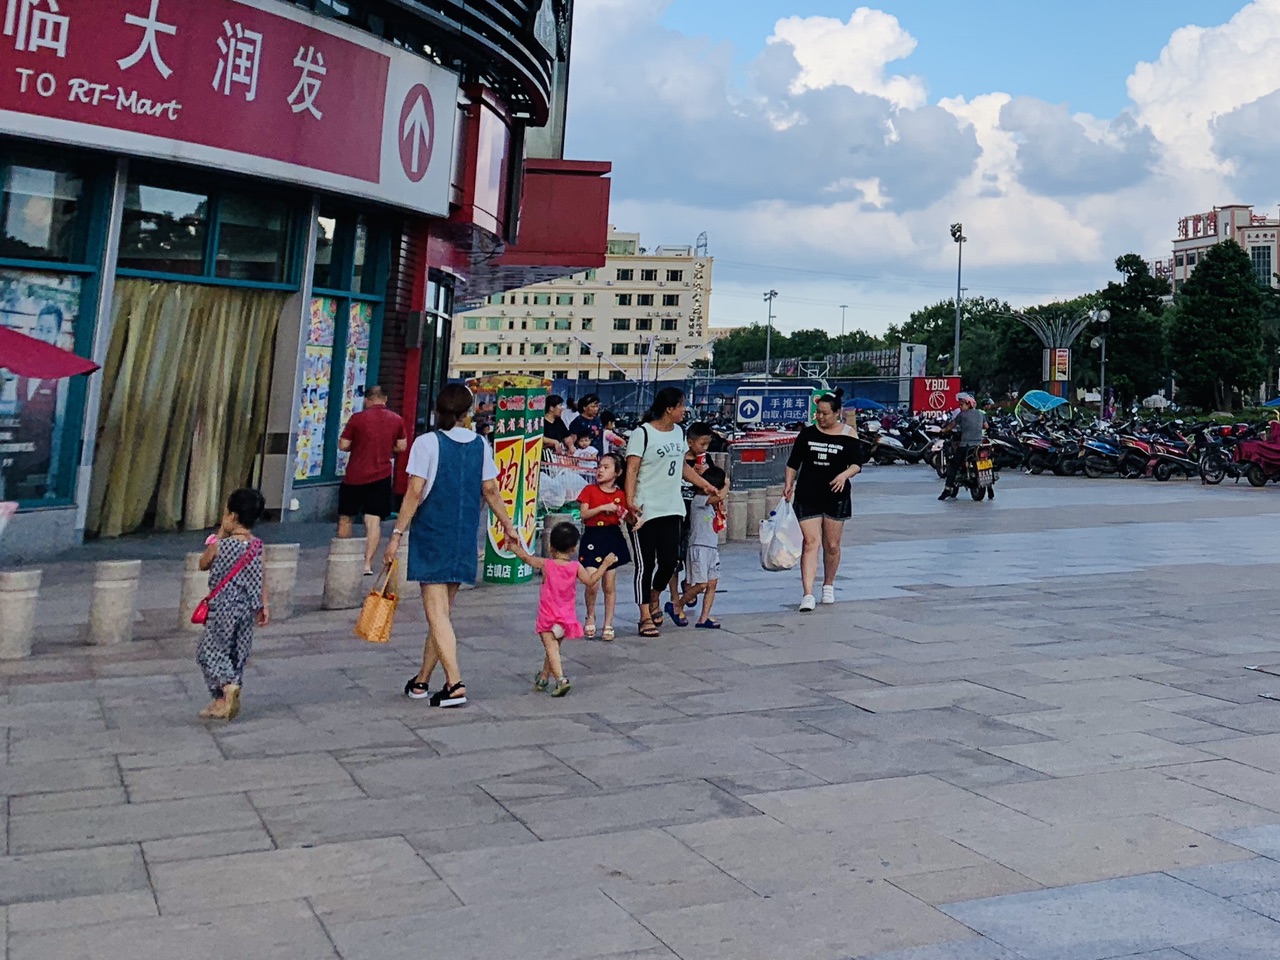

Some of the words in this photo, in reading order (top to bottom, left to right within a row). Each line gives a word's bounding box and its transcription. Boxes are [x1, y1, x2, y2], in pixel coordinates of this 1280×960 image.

[15, 67, 57, 98] TO
[68, 77, 183, 122] RT-Mart
[924, 378, 950, 391] YBDL
[769, 397, 806, 409] 手推车
[667, 460, 677, 477] 8
